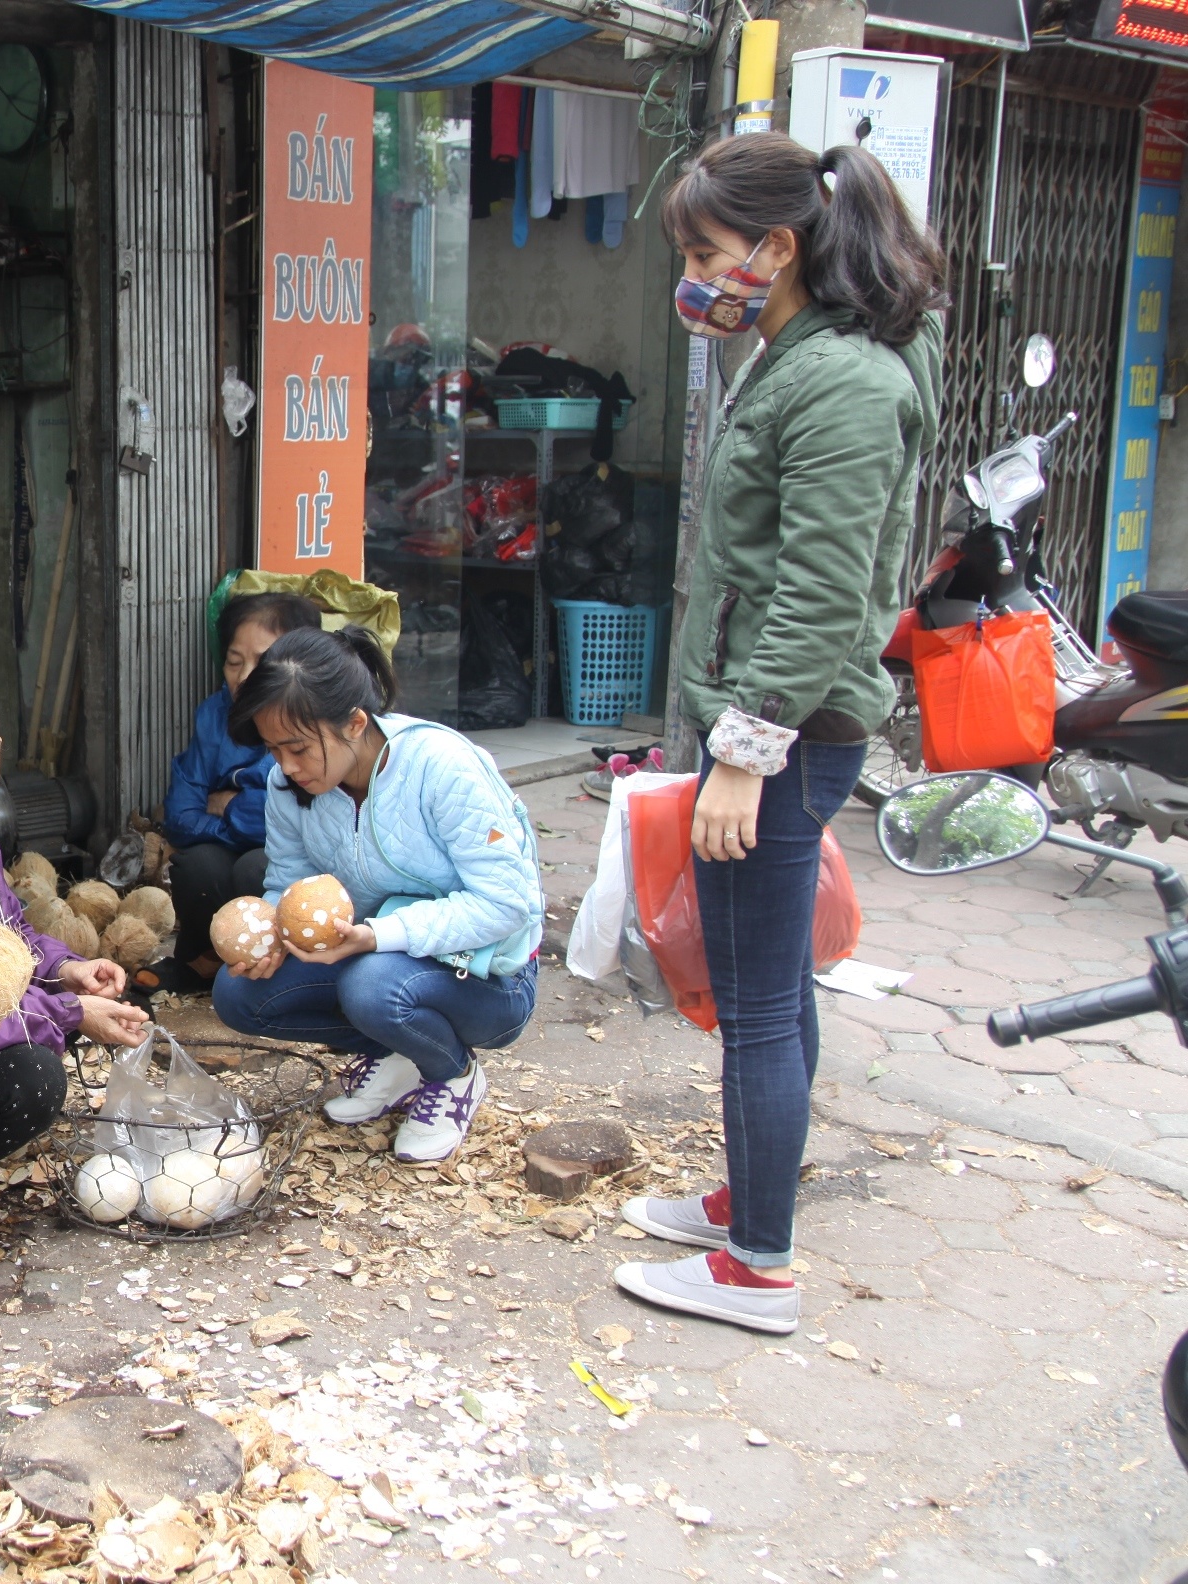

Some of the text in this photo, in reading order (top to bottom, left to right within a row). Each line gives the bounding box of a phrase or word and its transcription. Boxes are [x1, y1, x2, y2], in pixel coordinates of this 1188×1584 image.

[848, 108, 883, 119] VNPT
[287, 113, 354, 204] BÁN
[887, 168, 920, 179] 7.25.76.76
[273, 238, 363, 324] BUÔN
[1137, 282, 1161, 333] CÁO
[283, 355, 349, 441] BÁN
[1128, 356, 1158, 407] TRÊN
[1123, 438, 1149, 488] MỌI
[295, 470, 333, 559] LẺ
[1117, 495, 1147, 552] CHẤT
